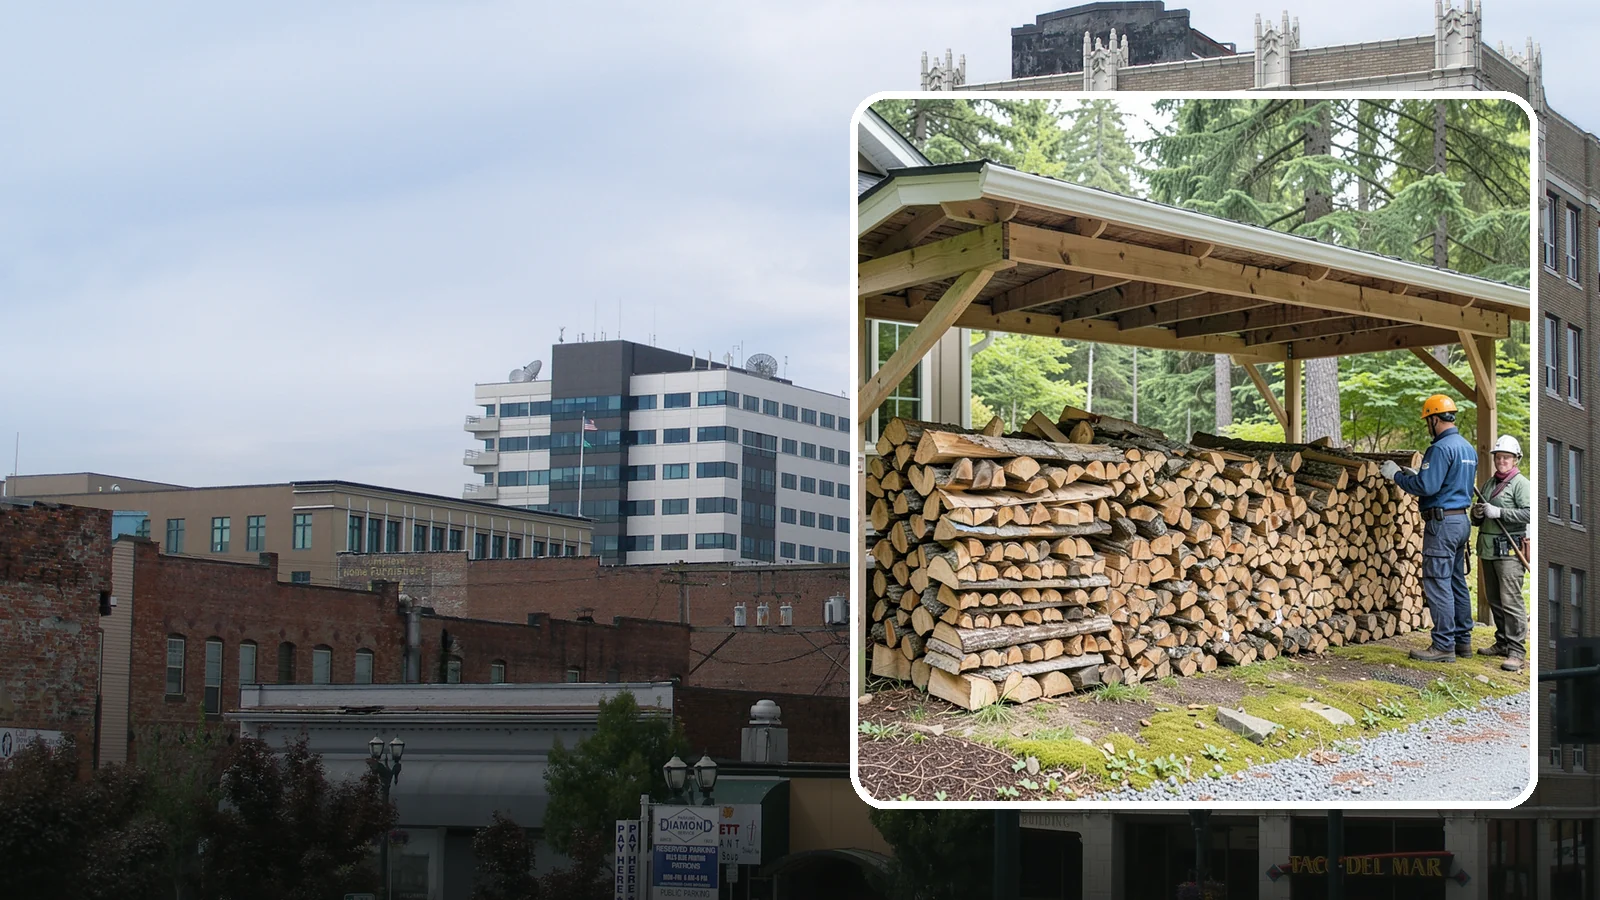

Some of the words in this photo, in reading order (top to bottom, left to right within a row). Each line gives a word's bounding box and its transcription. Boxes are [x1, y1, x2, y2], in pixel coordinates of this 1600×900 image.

[343, 567, 368, 577] Home
[370, 566, 427, 577] Furnishers
[660, 818, 713, 833] DIAMOND
[1022, 815, 1069, 827] BUILDING
[617, 824, 625, 853] PAY
[628, 824, 637, 853] PAY
[656, 845, 688, 853] RESERVED
[689, 846, 716, 854] PARKING
[721, 851, 739, 862] Soup
[671, 862, 701, 870] PATRONS
[1289, 855, 1328, 874] TAC
[1345, 856, 1386, 876] DEL
[1392, 857, 1443, 877] MAR
[617, 855, 625, 894] HERE
[627, 855, 636, 894] HERE
[660, 889, 682, 897] PUBLIC
[683, 889, 710, 898] PARKING
